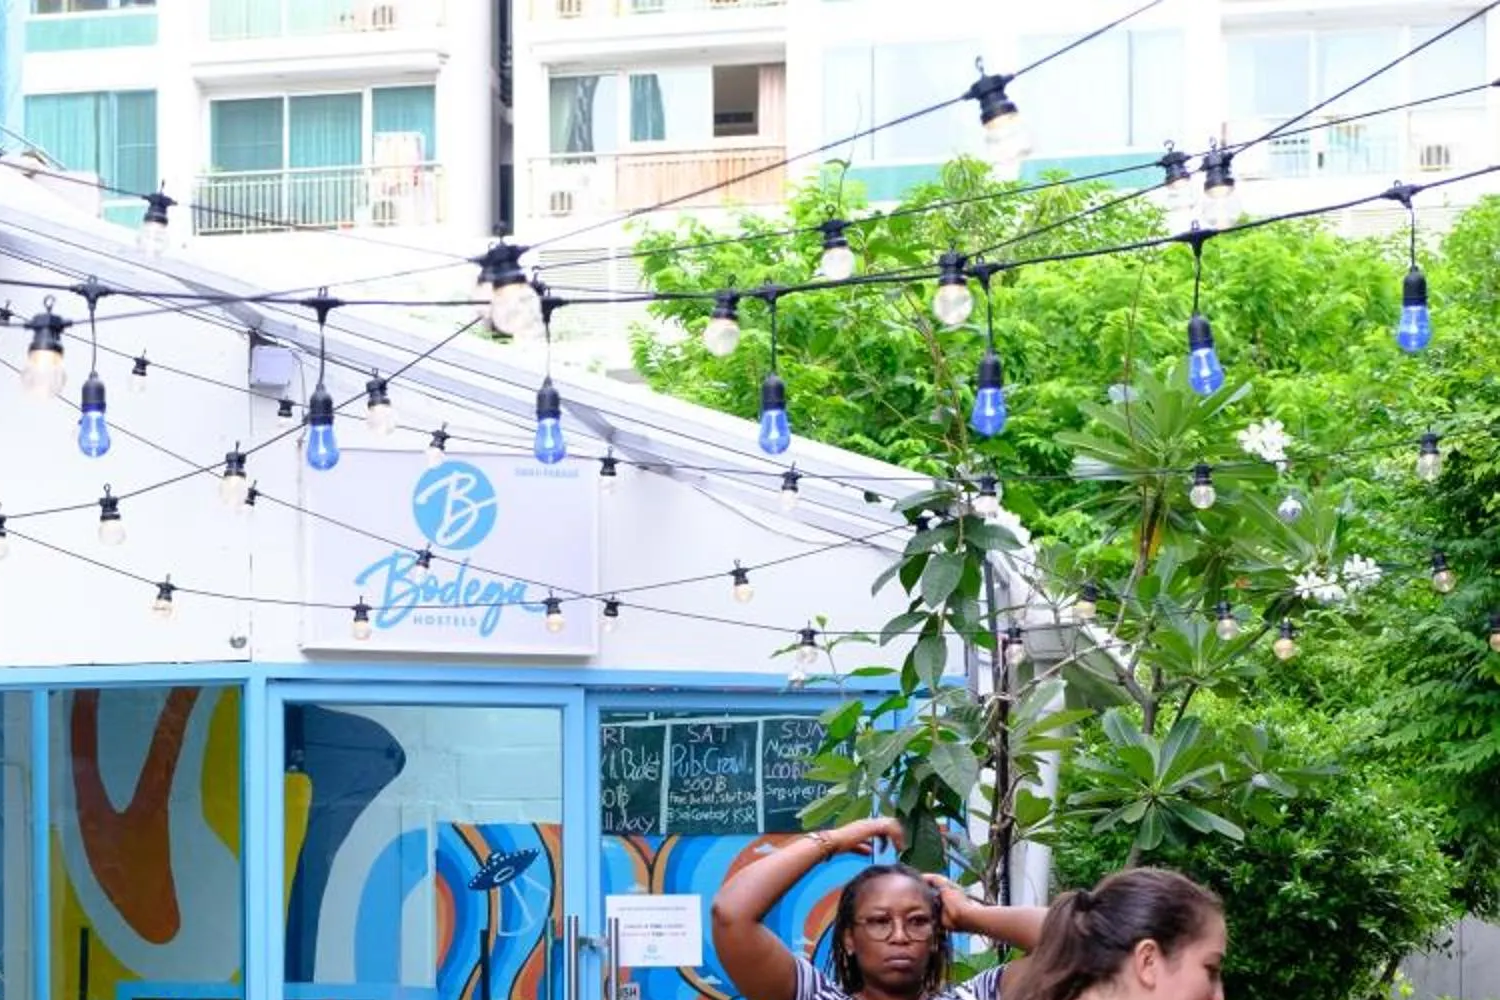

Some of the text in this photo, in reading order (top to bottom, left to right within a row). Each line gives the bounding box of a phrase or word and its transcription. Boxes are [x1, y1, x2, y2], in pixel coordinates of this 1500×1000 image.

[355, 550, 547, 637] Bodega
[413, 614, 477, 628] HOSTELS
[603, 726, 626, 746] RI
[687, 722, 732, 743] SAT
